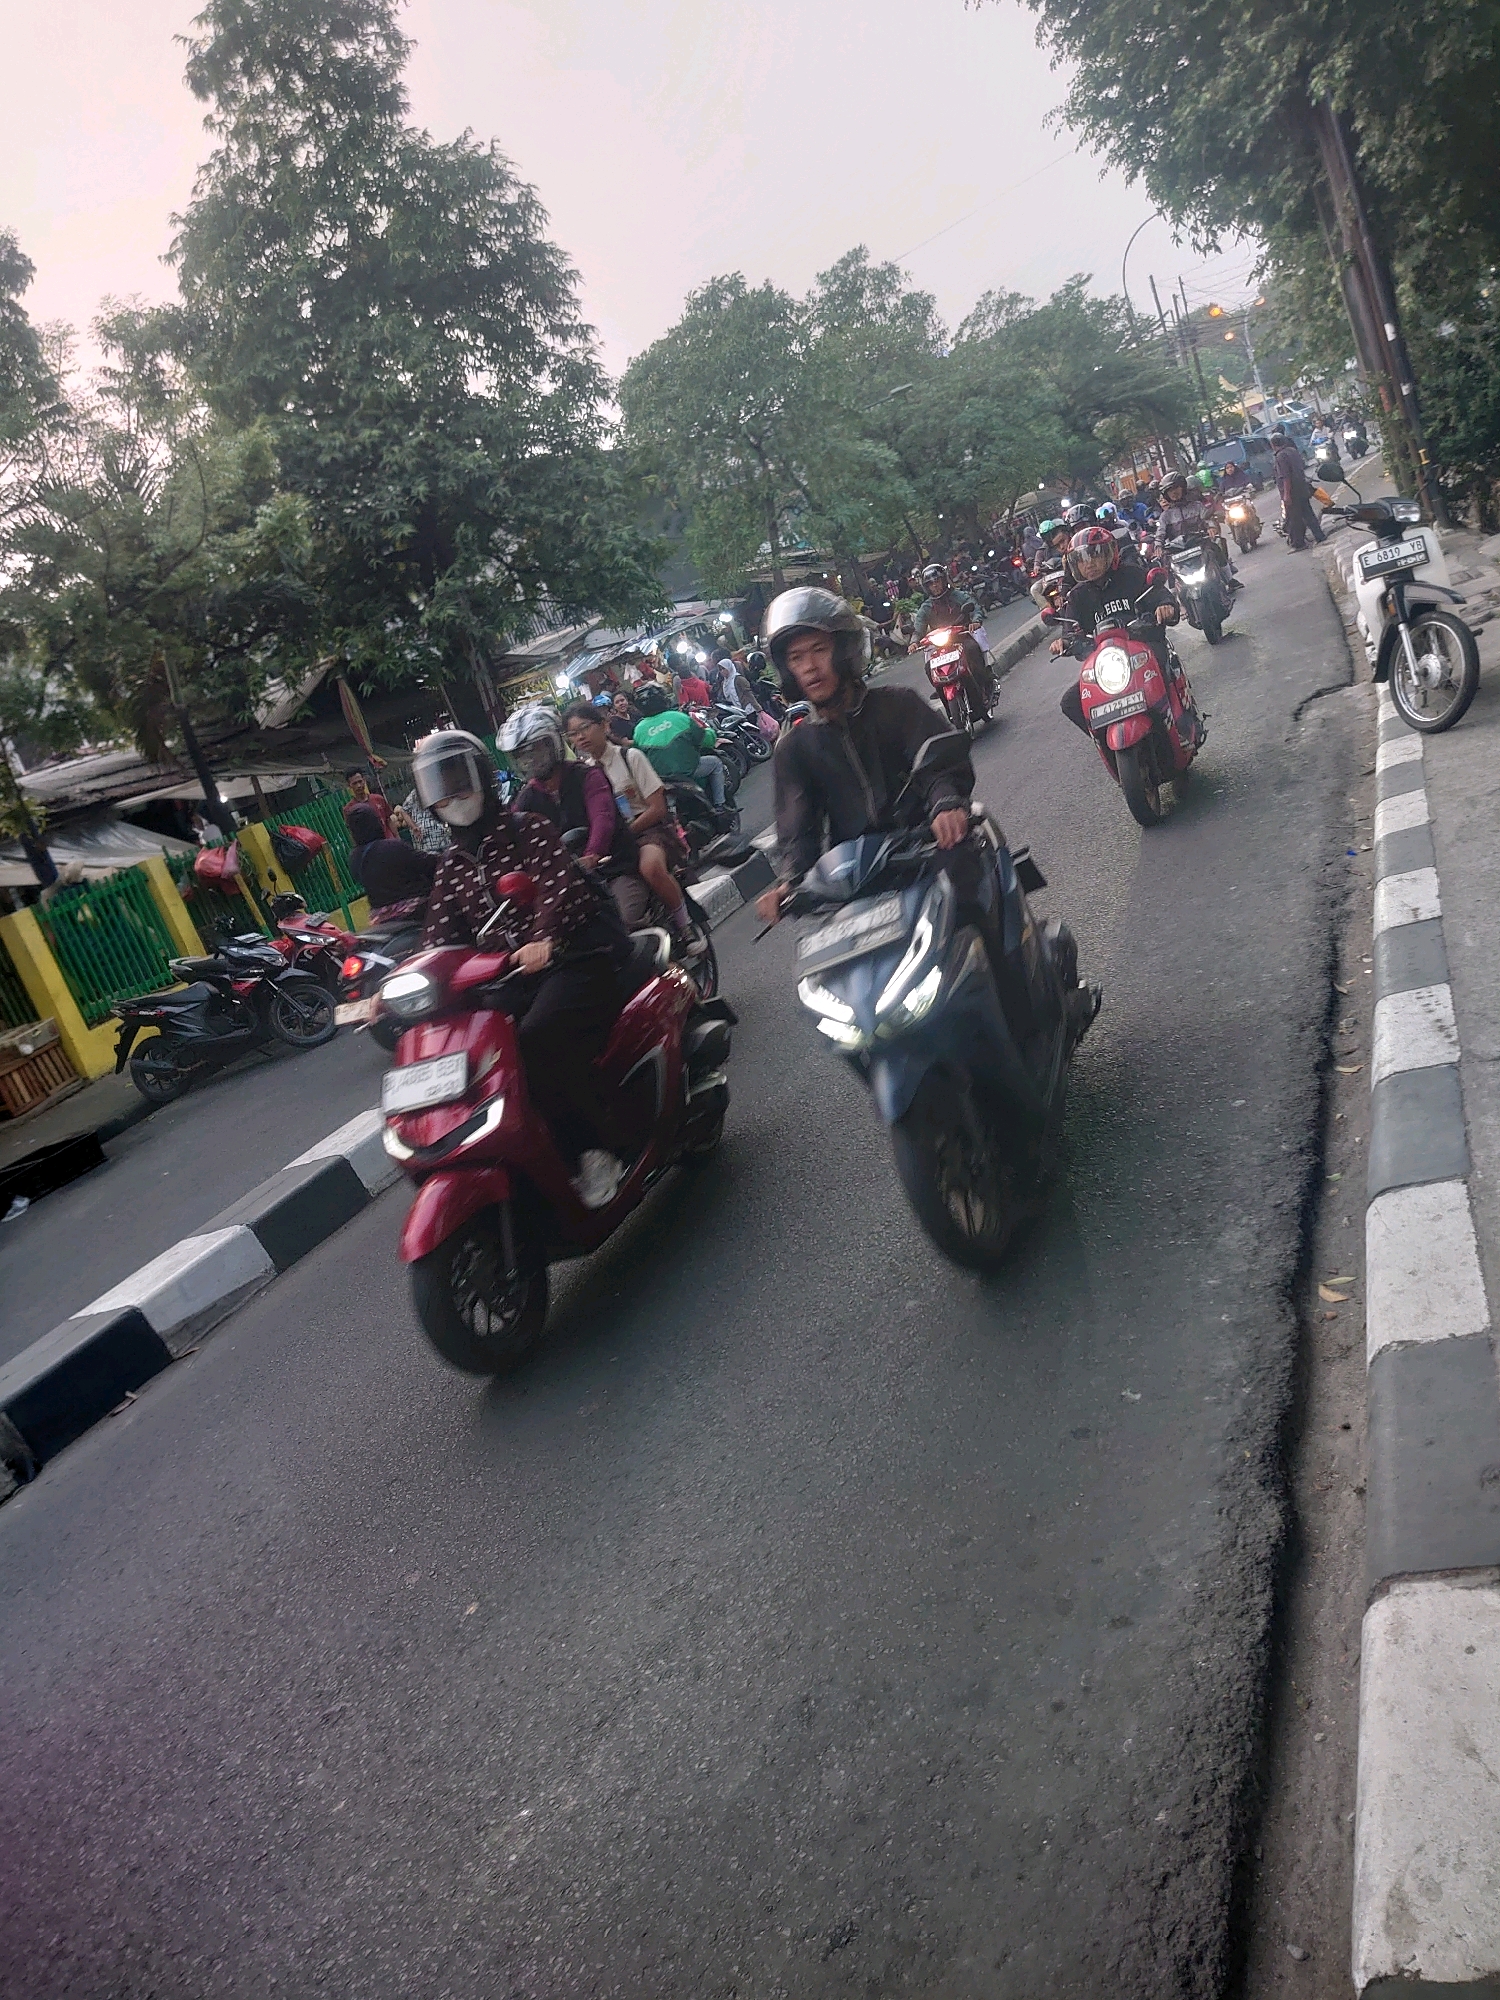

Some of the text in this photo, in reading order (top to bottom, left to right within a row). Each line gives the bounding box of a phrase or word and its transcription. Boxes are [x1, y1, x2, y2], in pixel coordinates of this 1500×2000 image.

[1364, 557, 1370, 566] E
[1377, 547, 1400, 562] 6819
[1410, 541, 1422, 551] YB
[648, 720, 672, 736] Grab
